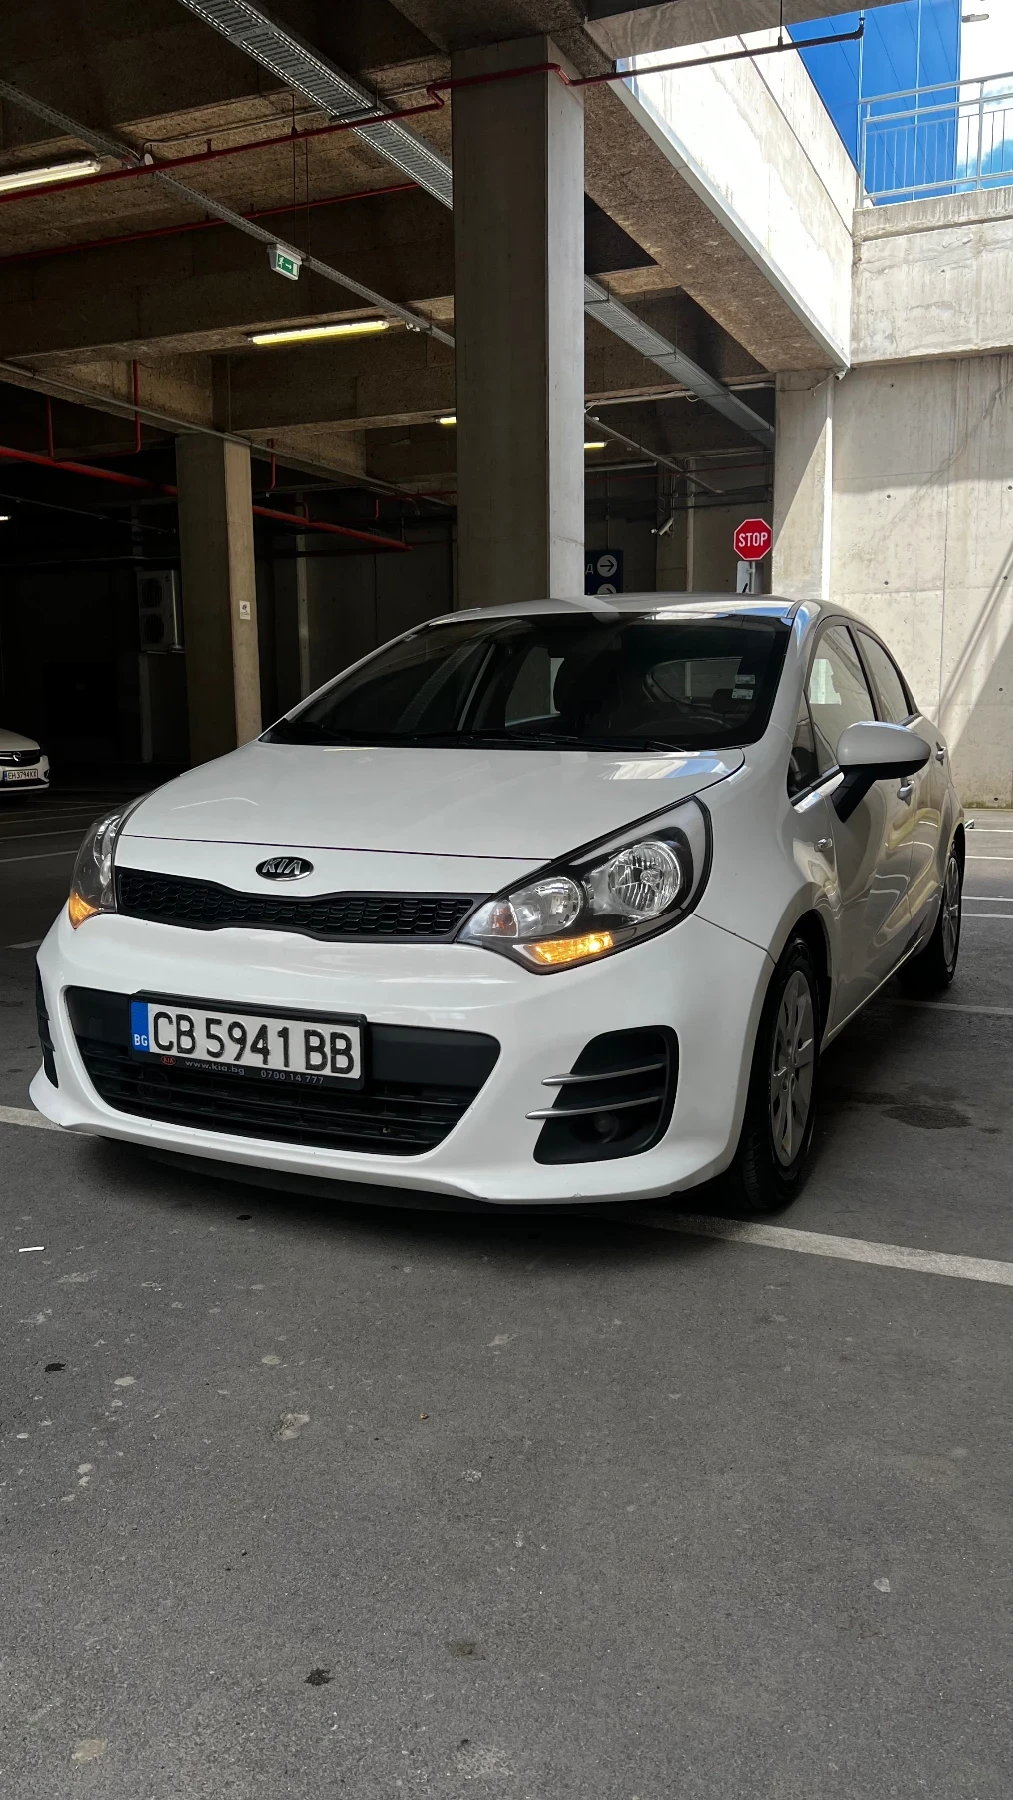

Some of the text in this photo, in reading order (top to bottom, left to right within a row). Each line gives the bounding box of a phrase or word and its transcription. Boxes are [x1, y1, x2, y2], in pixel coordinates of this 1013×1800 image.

[738, 532, 768, 547] STOP
[261, 858, 302, 875] KIA
[134, 1034, 148, 1046] BG
[153, 1011, 355, 1075] CB 5941 BB
[162, 1056, 175, 1065] KIA
[185, 1060, 324, 1085] www.kia.bg 0700 14 777
